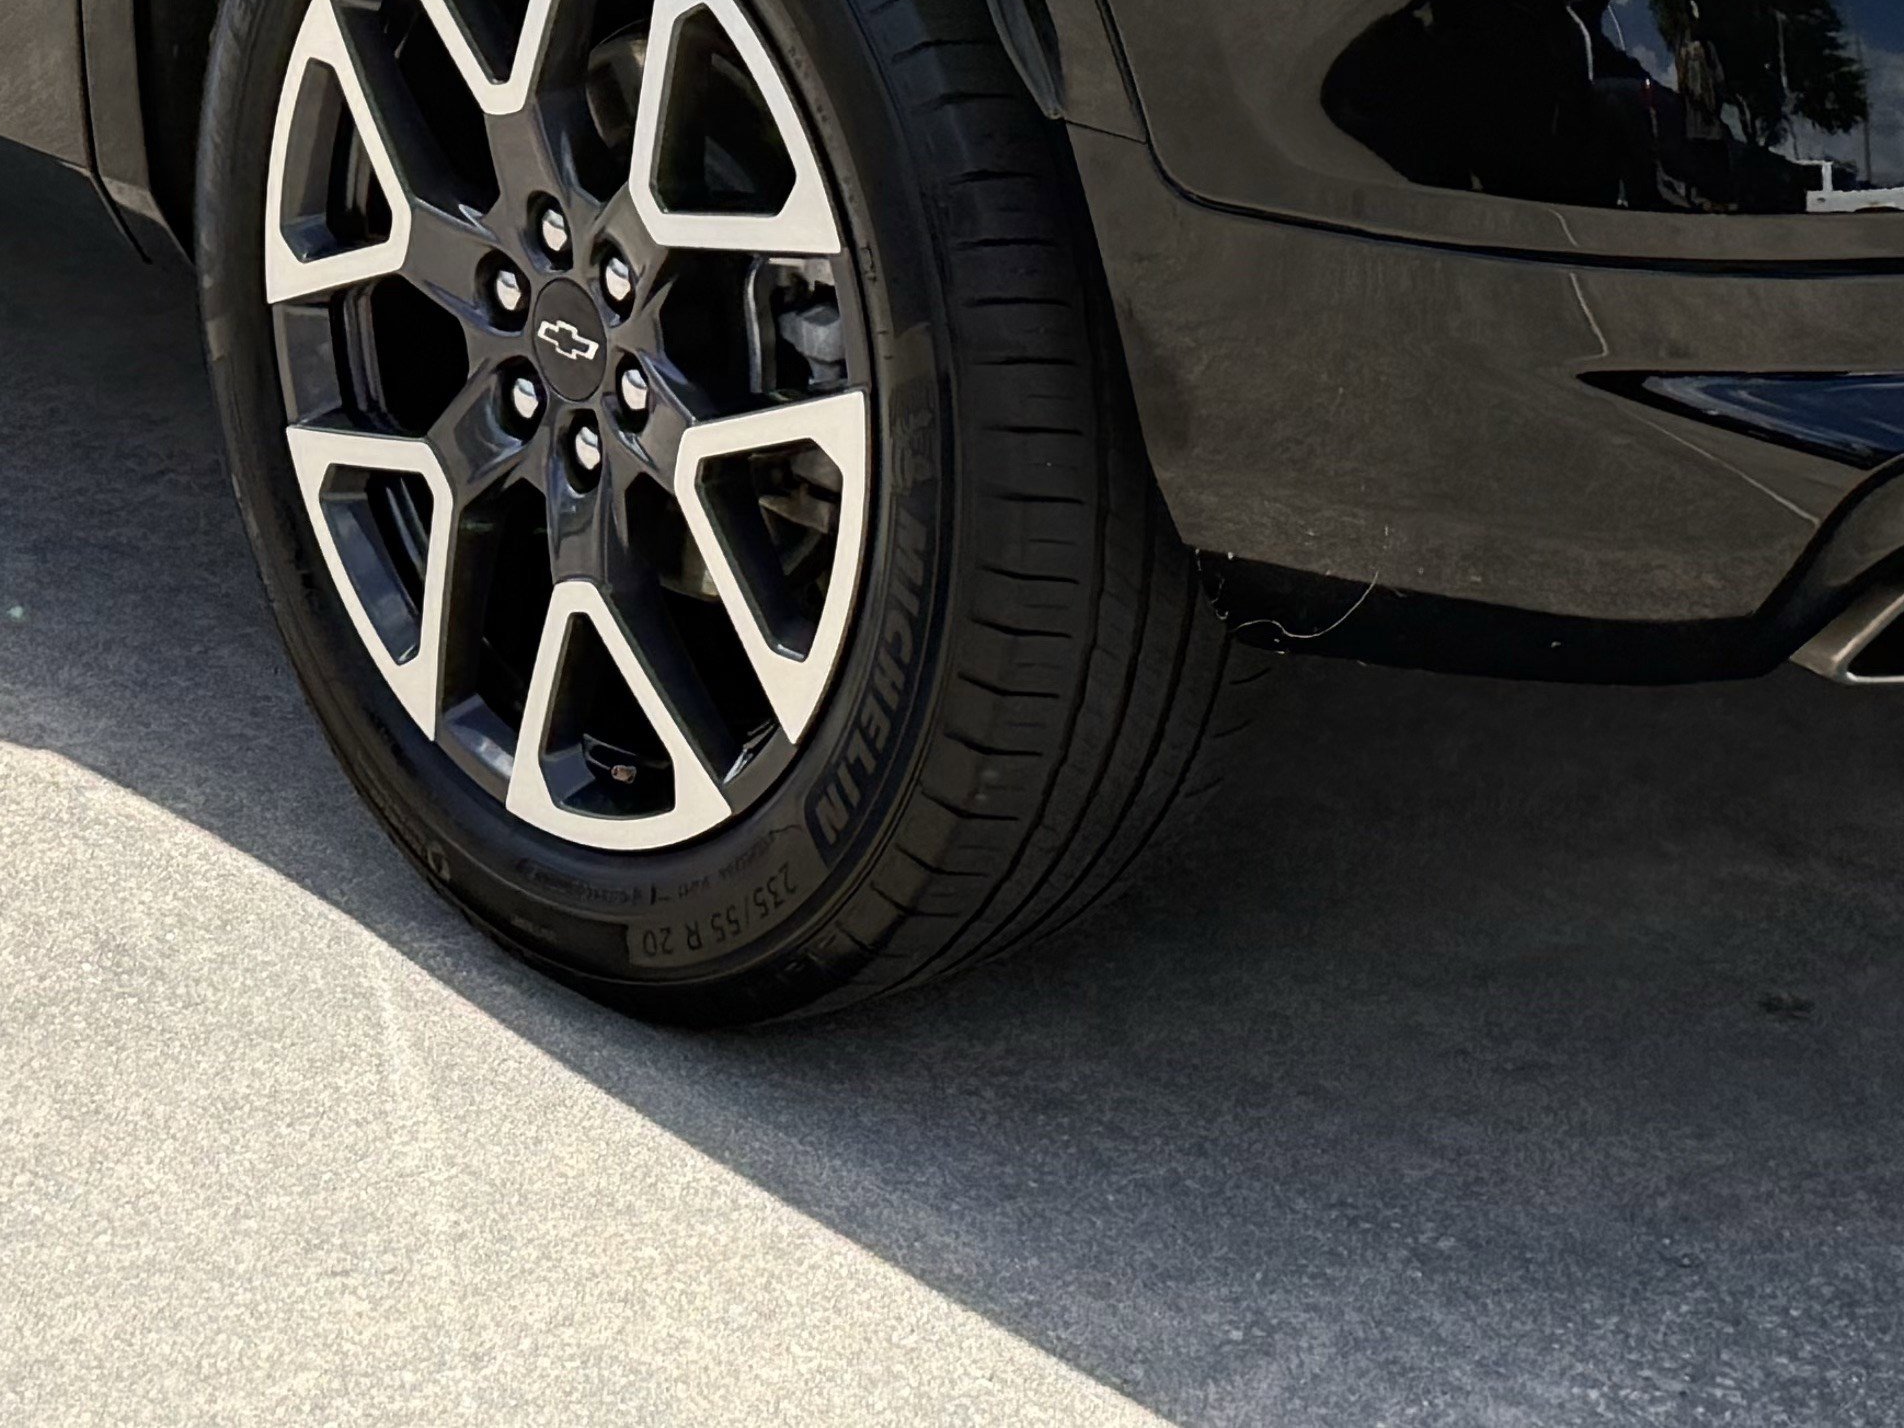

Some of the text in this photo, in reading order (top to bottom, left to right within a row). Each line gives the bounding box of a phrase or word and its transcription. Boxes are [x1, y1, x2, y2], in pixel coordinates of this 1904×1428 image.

[814, 504, 930, 846] MICHELIN
[642, 860, 798, 957] 235/55 R 20
